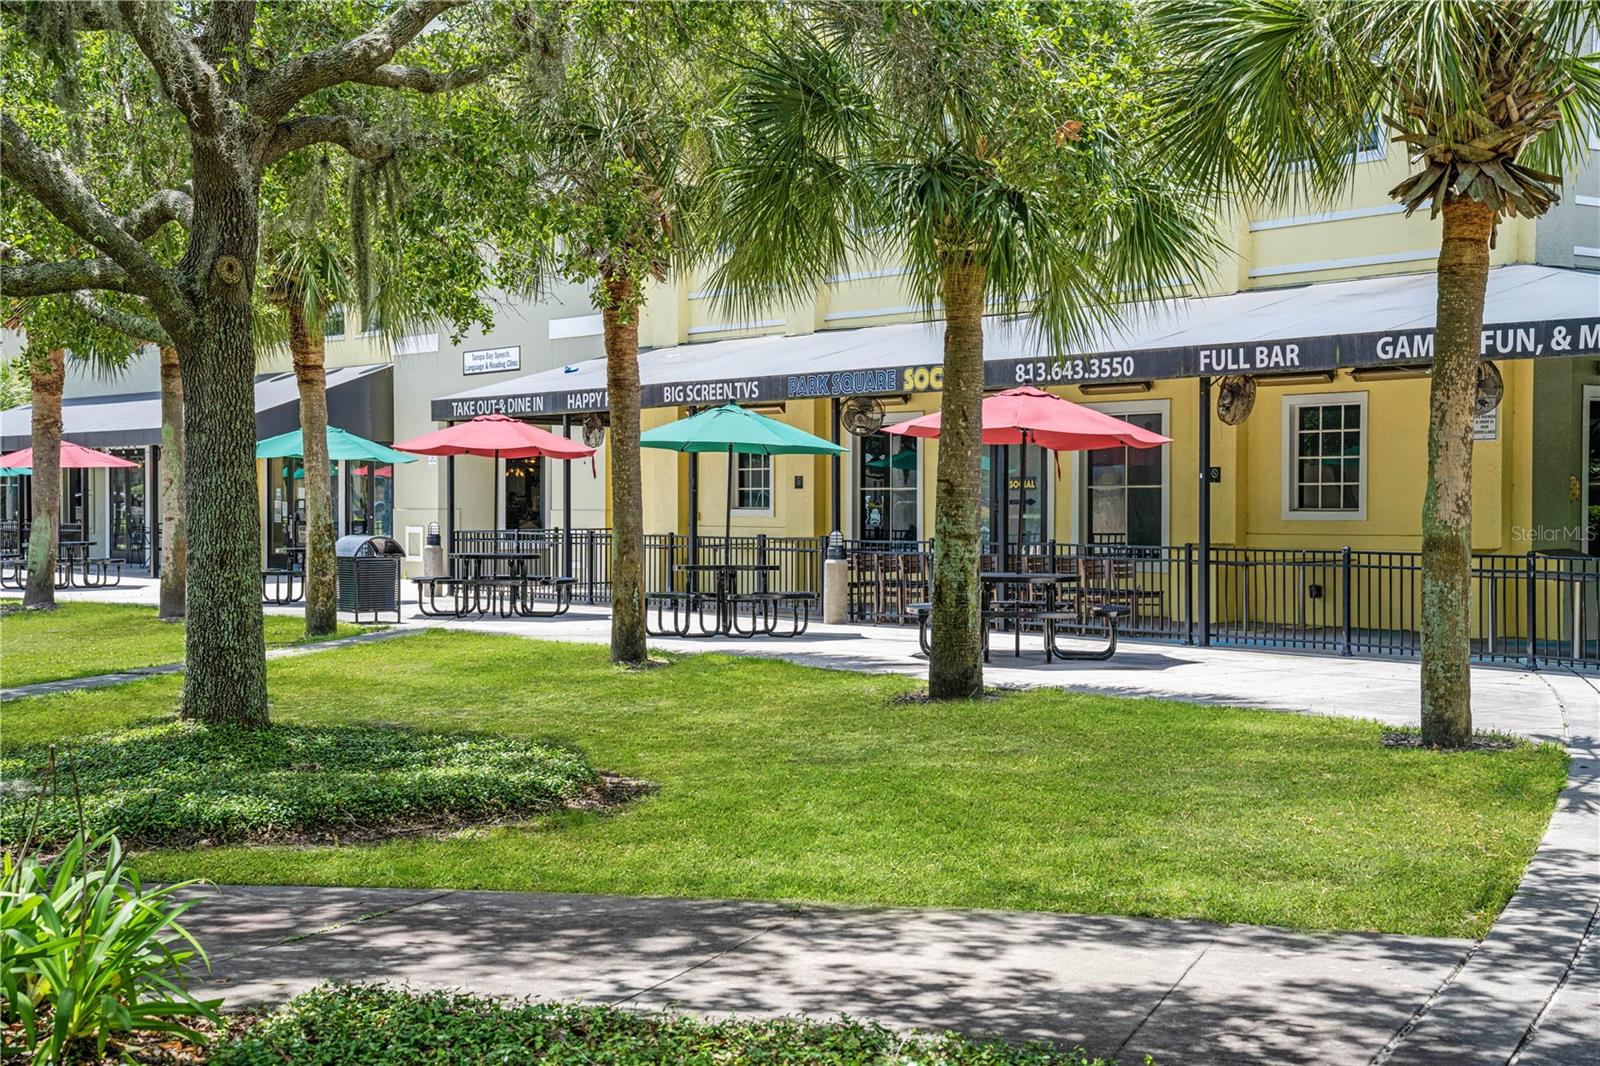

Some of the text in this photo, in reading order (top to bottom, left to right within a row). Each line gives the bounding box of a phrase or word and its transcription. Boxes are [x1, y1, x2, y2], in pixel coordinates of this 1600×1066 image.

[1376, 324, 1600, 359] GAM FUN, & M
[465, 364, 484, 372] Language
[489, 361, 506, 369] Reading
[471, 353, 485, 362] Tampa
[1200, 344, 1300, 371] FULL BAR
[1015, 356, 1134, 382] 813.643.3550
[663, 381, 759, 402] BIG SCREEN TVS
[788, 366, 944, 397] PARK SQUARE SOC
[452, 396, 544, 416] TAKE OUT & DINE IN
[567, 391, 602, 409] HAPPY
